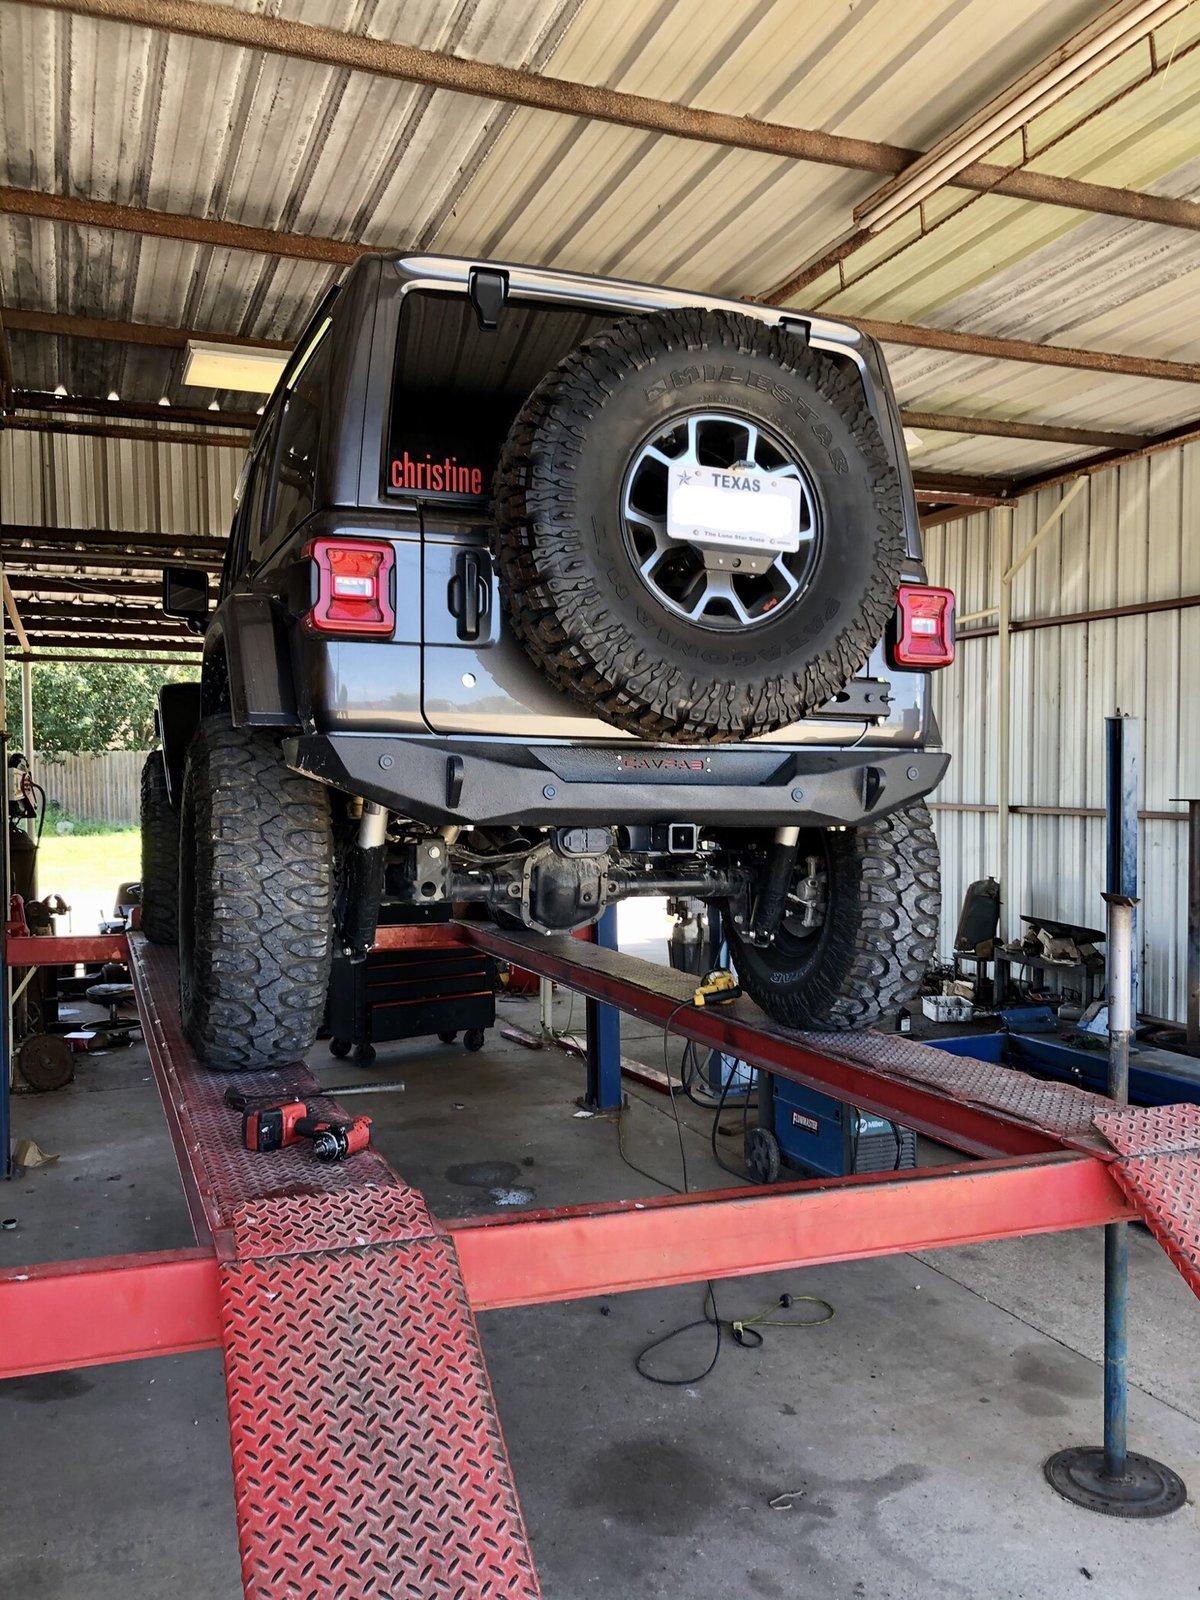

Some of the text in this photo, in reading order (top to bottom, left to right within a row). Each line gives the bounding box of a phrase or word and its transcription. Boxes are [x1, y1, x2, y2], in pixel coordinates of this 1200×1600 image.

[670, 364, 850, 476] MILESTAR
[391, 451, 482, 494] christine
[711, 473, 761, 492] TEXAS
[868, 1120, 884, 1128] Miller
